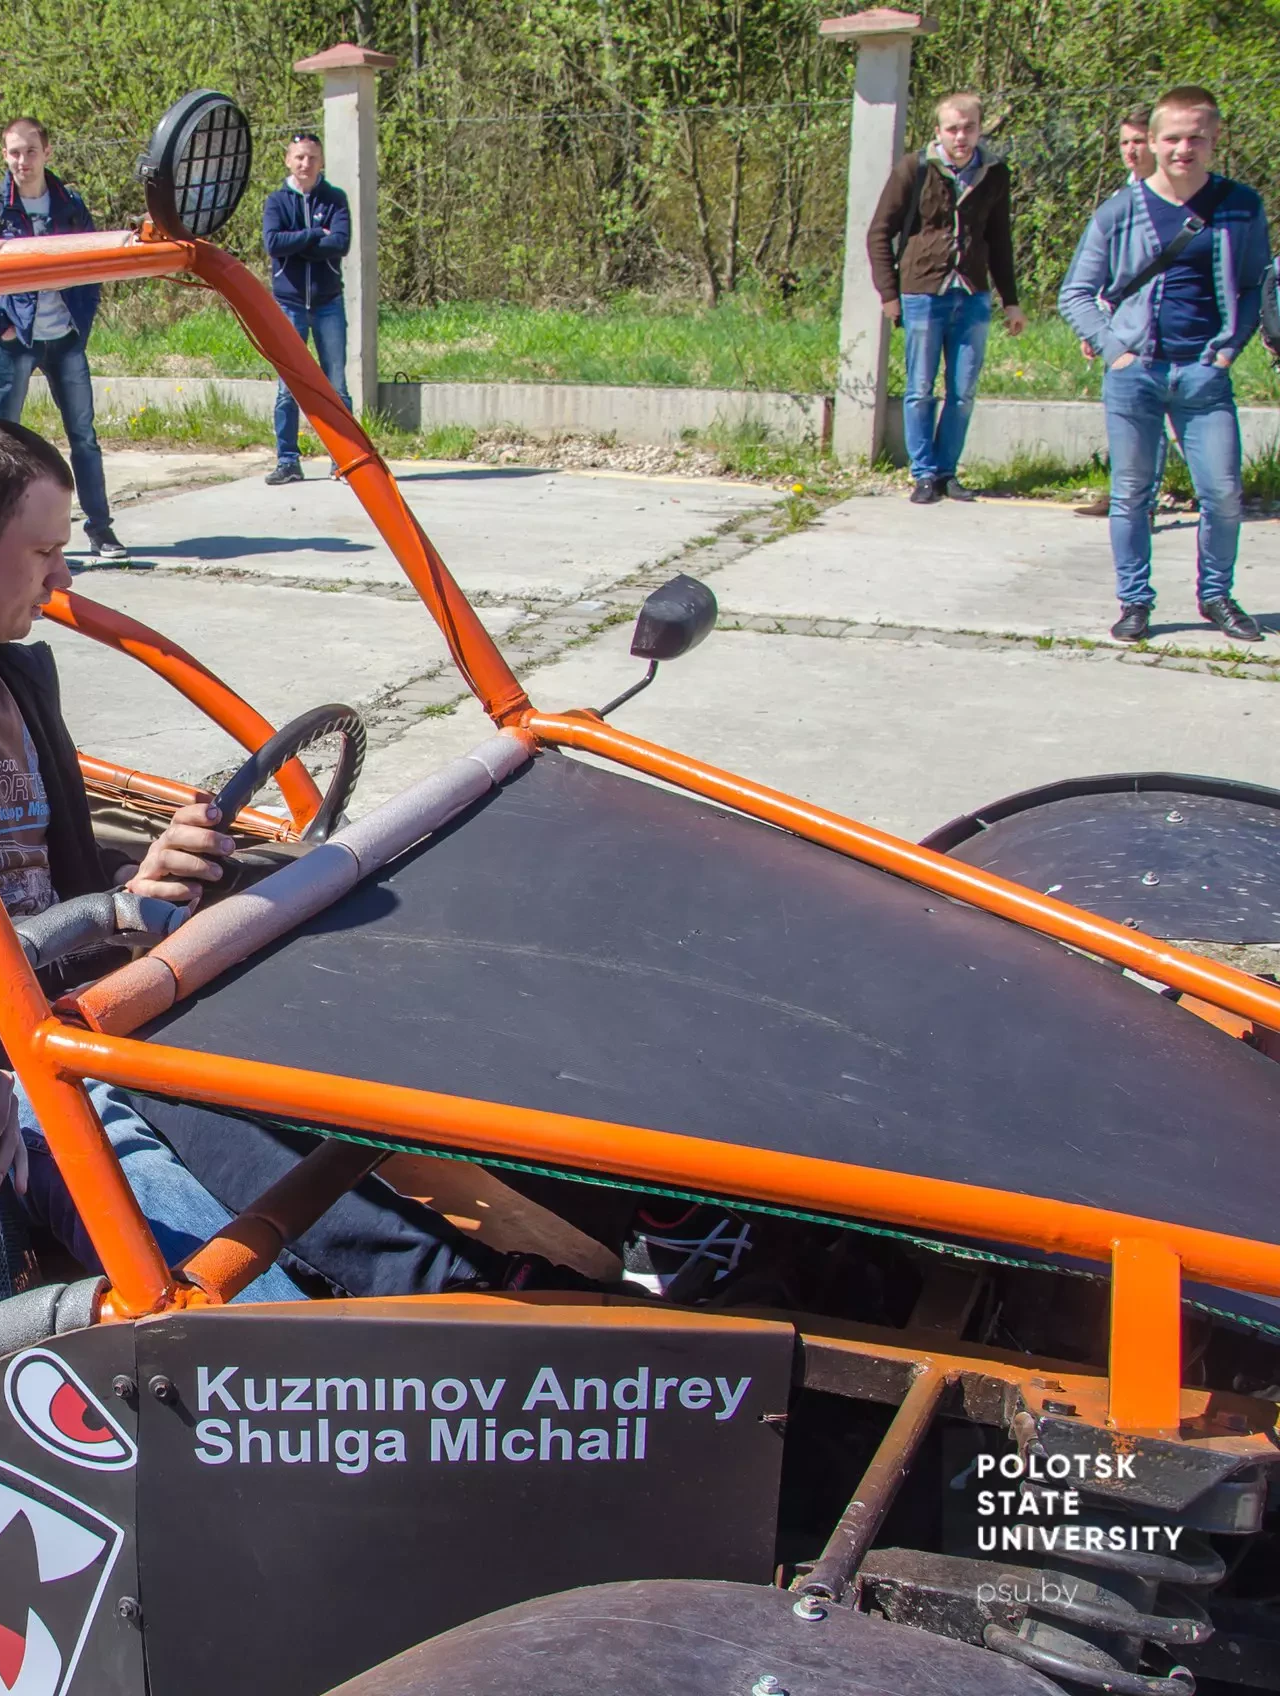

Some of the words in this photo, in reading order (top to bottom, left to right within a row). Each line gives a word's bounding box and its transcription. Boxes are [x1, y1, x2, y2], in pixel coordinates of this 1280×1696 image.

[522, 1366, 752, 1421] Andrey
[194, 1418, 407, 1475] Shulga
[430, 1417, 648, 1463] Michail
